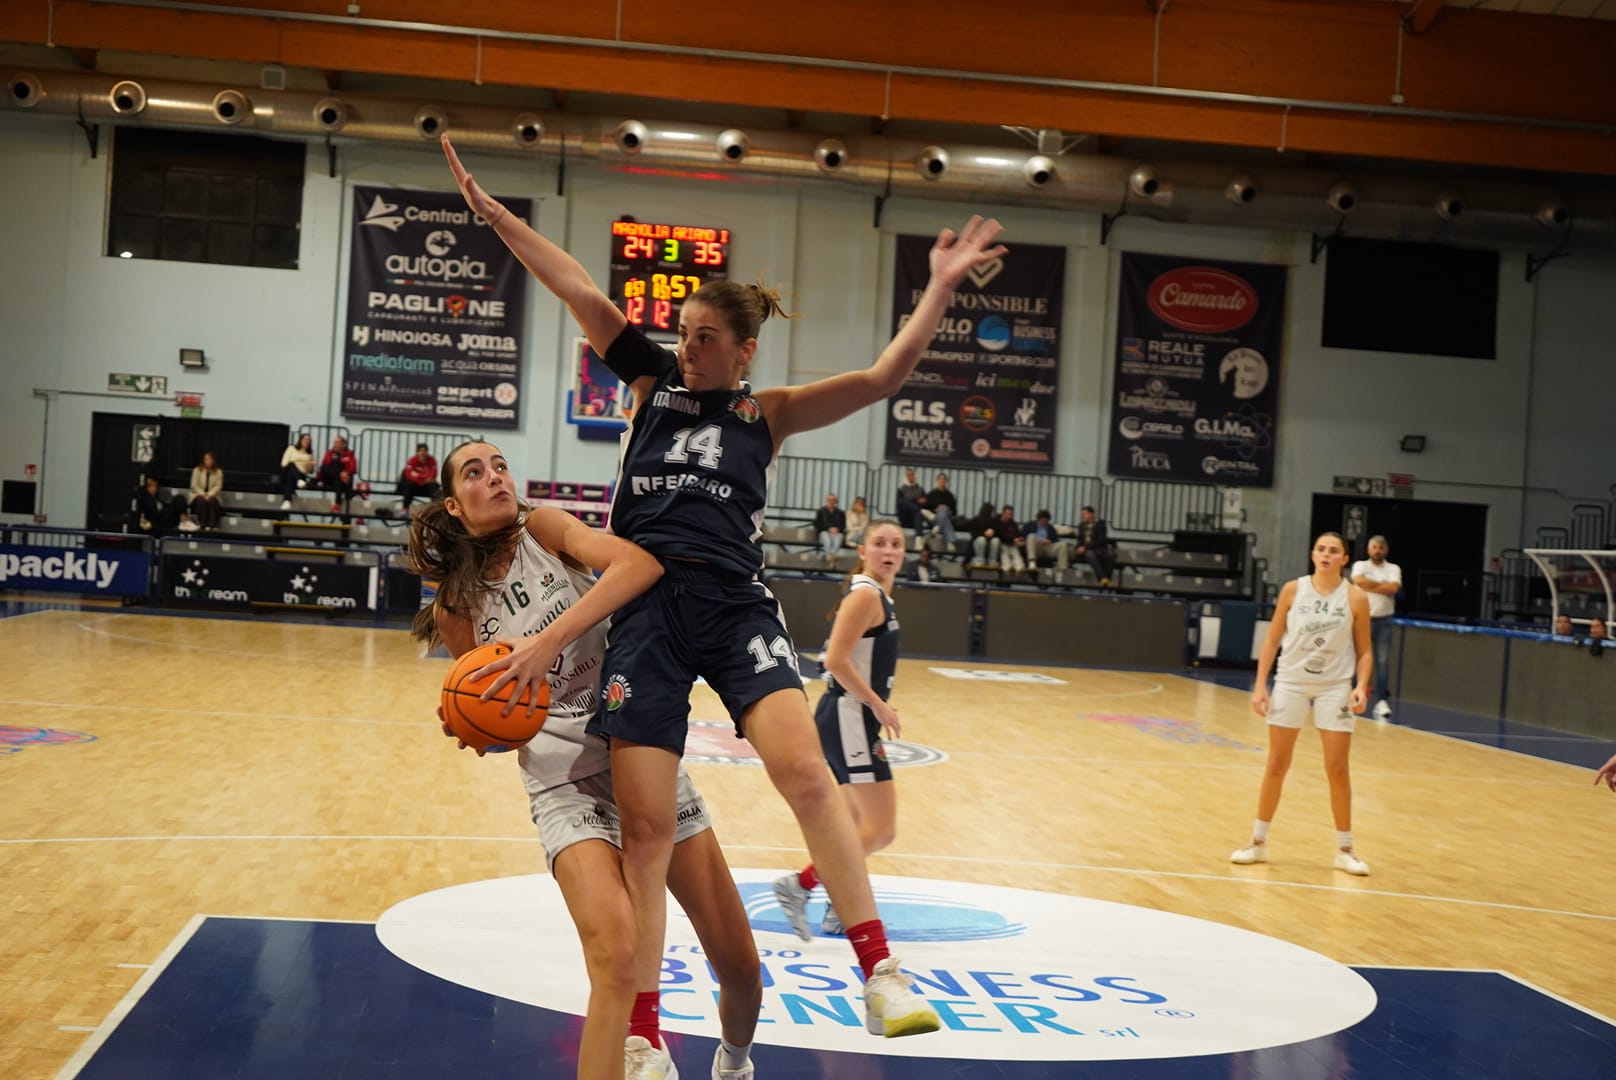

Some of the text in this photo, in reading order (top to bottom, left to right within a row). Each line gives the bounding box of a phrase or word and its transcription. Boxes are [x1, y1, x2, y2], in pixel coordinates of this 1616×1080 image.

[404, 206, 468, 225] Central
[624, 236, 722, 265] 24 3 35
[385, 254, 486, 281] autopia
[368, 291, 505, 317] PAGLIONE
[912, 288, 1048, 314] RPONSIBLE
[1159, 282, 1248, 311] Camardo
[374, 328, 452, 347] HINOJOSA
[1148, 340, 1205, 356] REALE
[350, 353, 434, 372] mediaform
[437, 386, 492, 399] expert
[664, 424, 723, 470] 14
[500, 581, 531, 617] 16
[1315, 600, 1329, 614] 24
[747, 635, 803, 674] 14
[549, 656, 601, 690] ONSIBLE
[676, 805, 700, 821] OLIA
[656, 987, 1087, 1036] CNER
